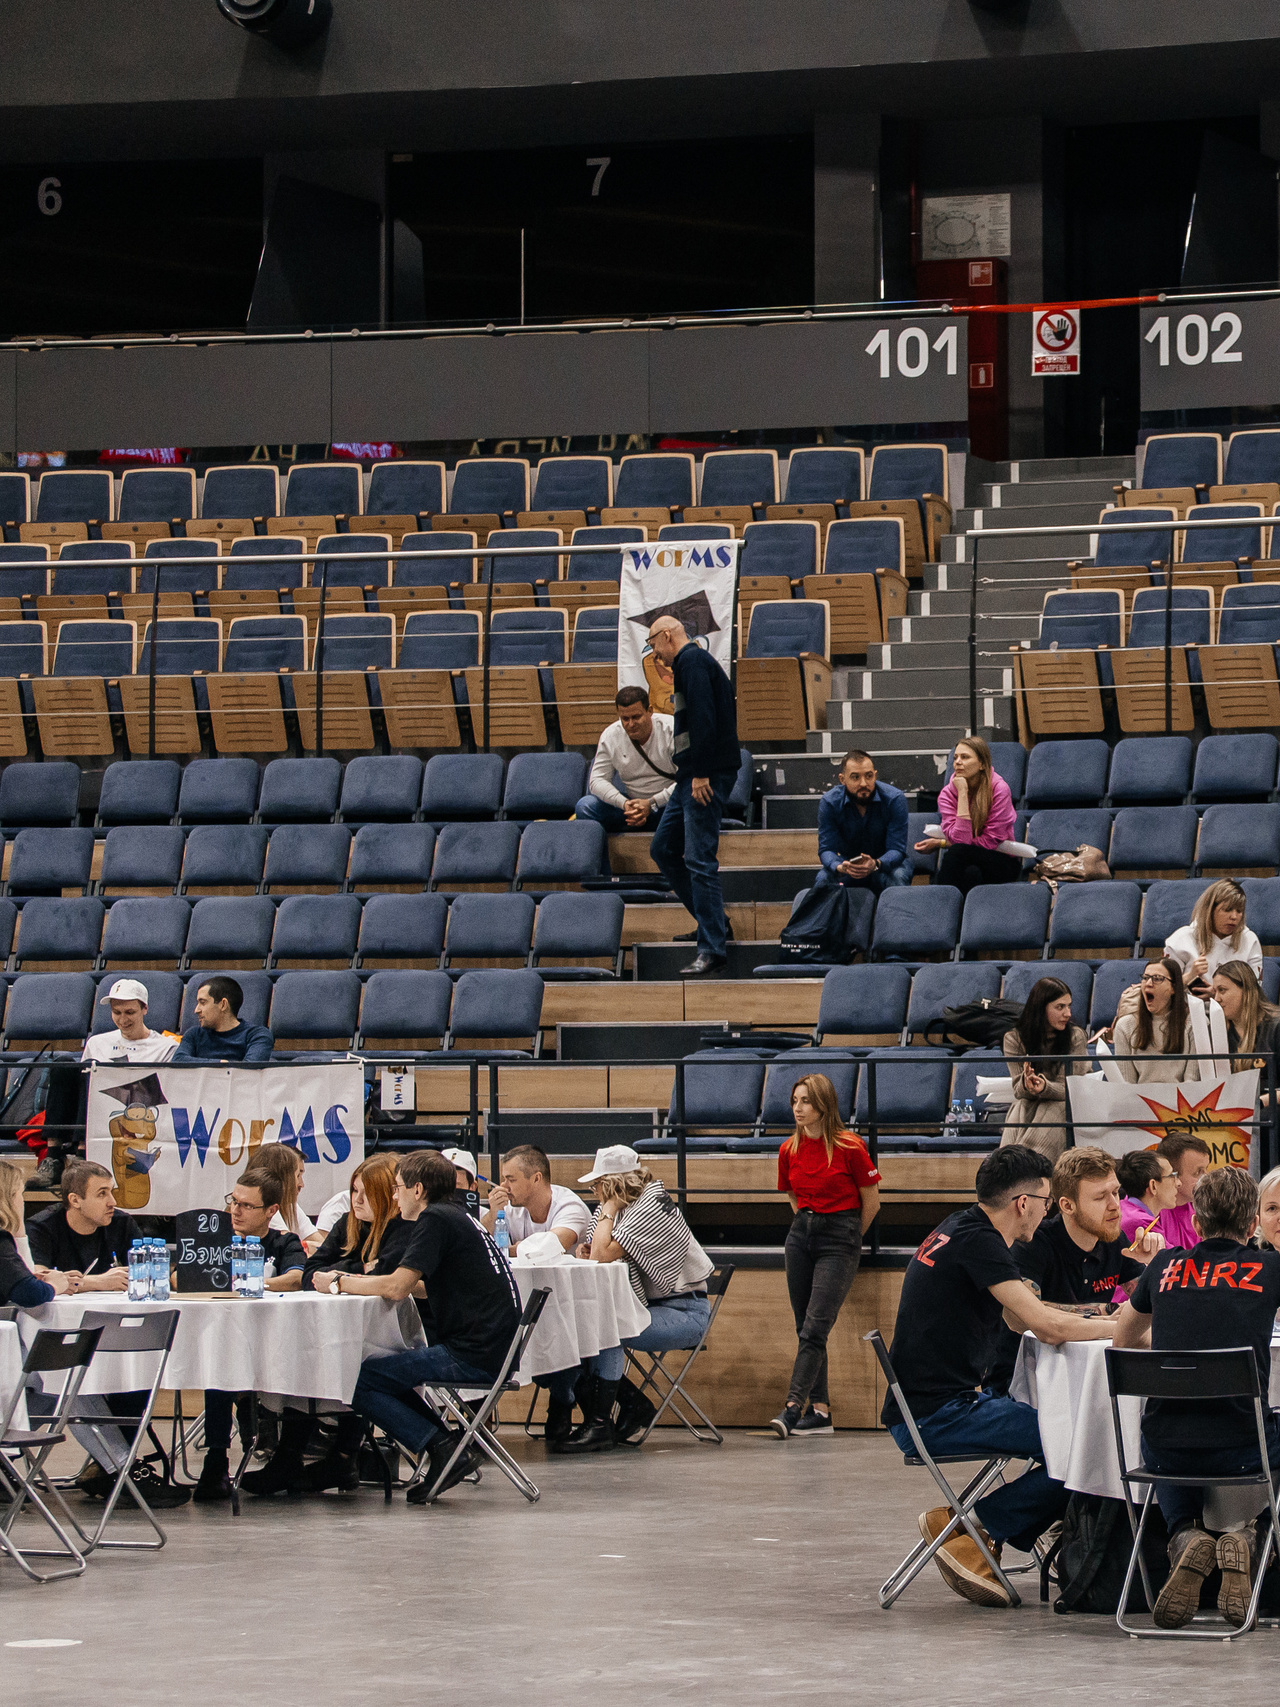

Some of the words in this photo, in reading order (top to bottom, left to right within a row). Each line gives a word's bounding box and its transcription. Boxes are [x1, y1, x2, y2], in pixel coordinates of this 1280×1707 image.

[38, 176, 62, 215] 6
[586, 157, 611, 196] 7
[865, 326, 958, 379] 101
[1144, 311, 1243, 366] 102
[466, 1192, 478, 1209] 10
[198, 1214, 220, 1233] 20
[1158, 1258, 1263, 1293] #NRZ
